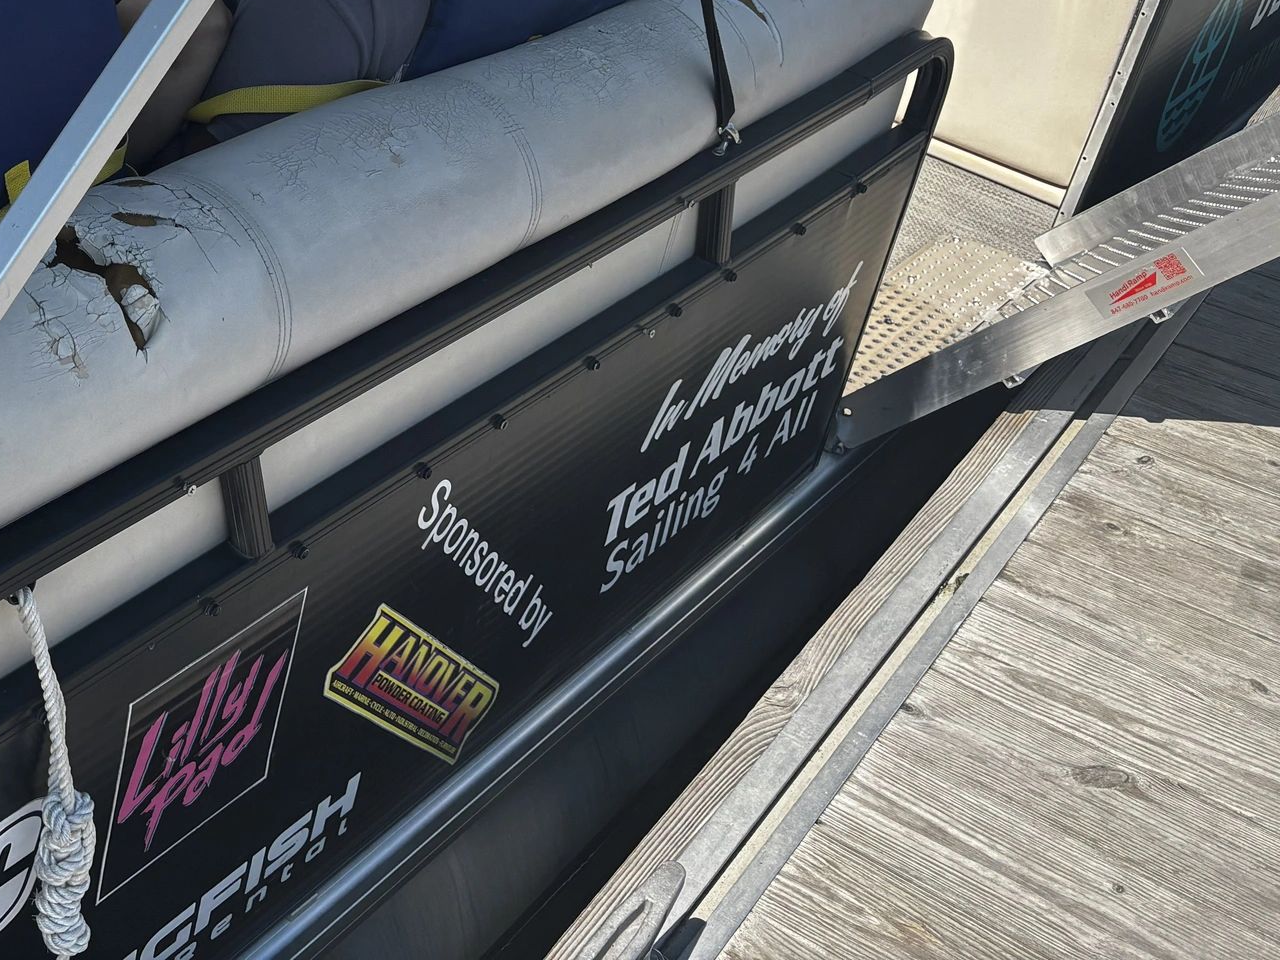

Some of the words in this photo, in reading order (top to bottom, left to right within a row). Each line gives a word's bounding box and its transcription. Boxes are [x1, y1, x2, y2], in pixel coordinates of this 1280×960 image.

[604, 440, 692, 547] Ted
[688, 336, 844, 480] Abbott
[640, 379, 689, 453] In
[684, 304, 824, 421] Memory
[822, 260, 864, 337] of
[417, 479, 534, 616] Sponsored
[518, 584, 553, 648] by
[599, 466, 729, 594] Sailing
[736, 432, 761, 475] 4
[763, 390, 819, 459] All
[117, 649, 265, 824] Lilly
[335, 613, 494, 744] HANOVER
[371, 672, 413, 703] POWDER
[409, 695, 446, 725] COATING
[122, 772, 362, 960] GFISH
